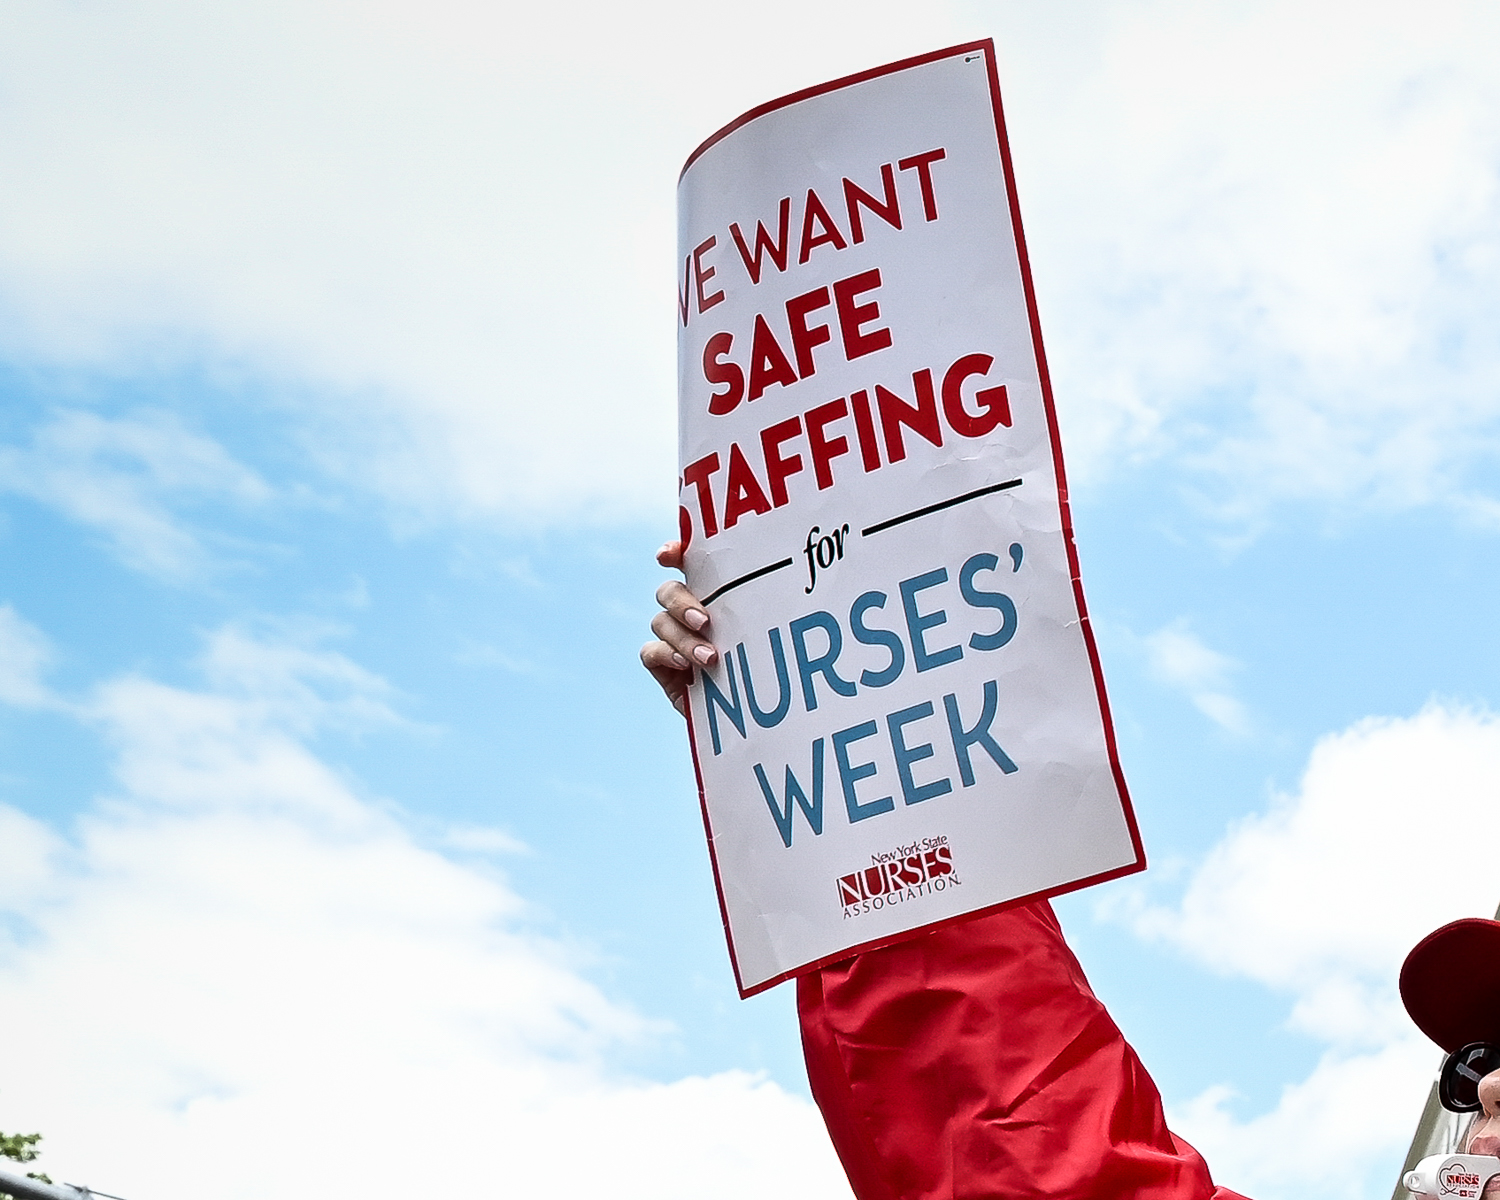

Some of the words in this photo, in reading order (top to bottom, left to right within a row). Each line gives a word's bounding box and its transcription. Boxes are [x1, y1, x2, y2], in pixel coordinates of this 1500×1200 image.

[729, 148, 946, 285] WANT
[703, 268, 892, 416] SAFE
[803, 524, 849, 593] for
[701, 543, 1024, 756] NURSES'
[754, 680, 1018, 848] WEEK
[836, 846, 954, 908] NURSES
[843, 869, 961, 919] ASSOCIATION
[871, 851, 896, 866] New
[896, 841, 921, 858] York
[922, 835, 948, 851] State
